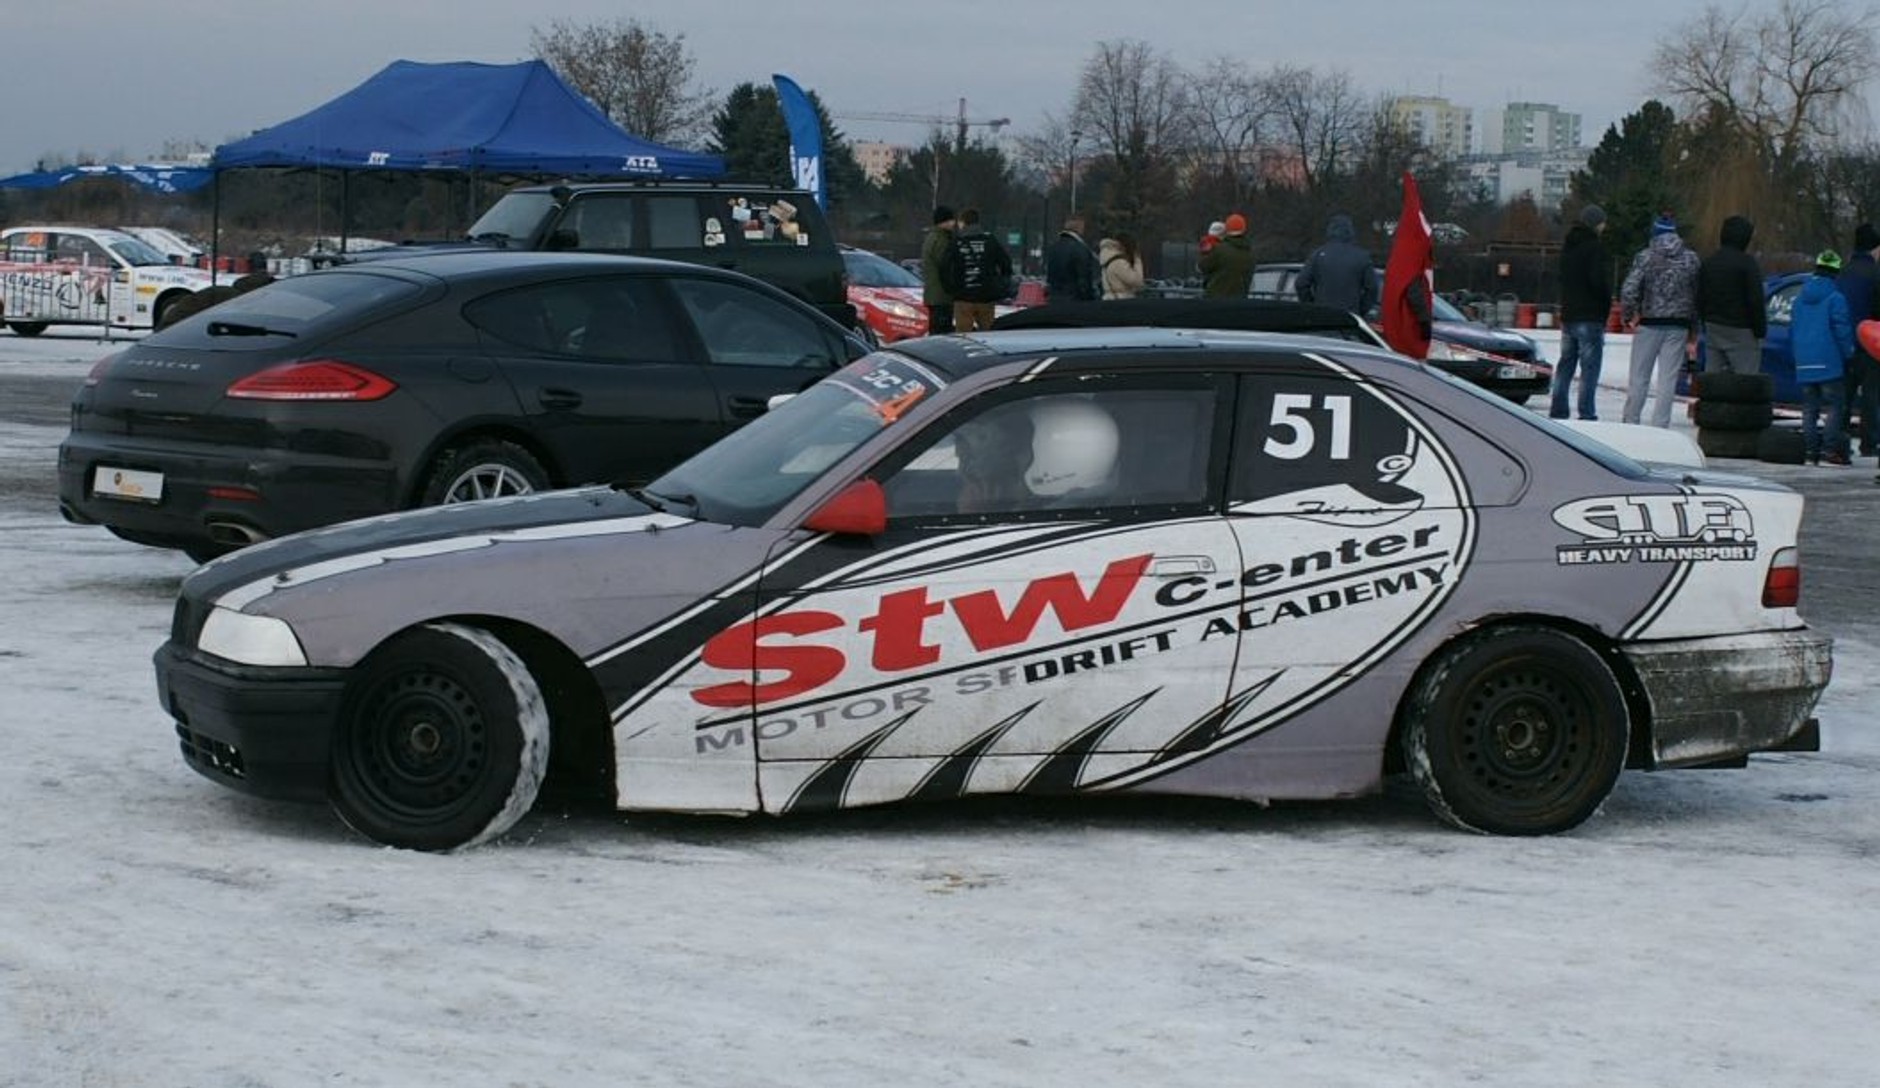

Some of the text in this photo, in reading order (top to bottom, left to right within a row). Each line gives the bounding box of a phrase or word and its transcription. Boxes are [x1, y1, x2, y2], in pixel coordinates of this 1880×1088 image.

[1263, 393, 1352, 460] 51
[1558, 544, 1758, 564] HEAVY TRANSPORT
[1023, 562, 1449, 684] DRIFT ACADEMY
[695, 685, 934, 753] MOTOR
